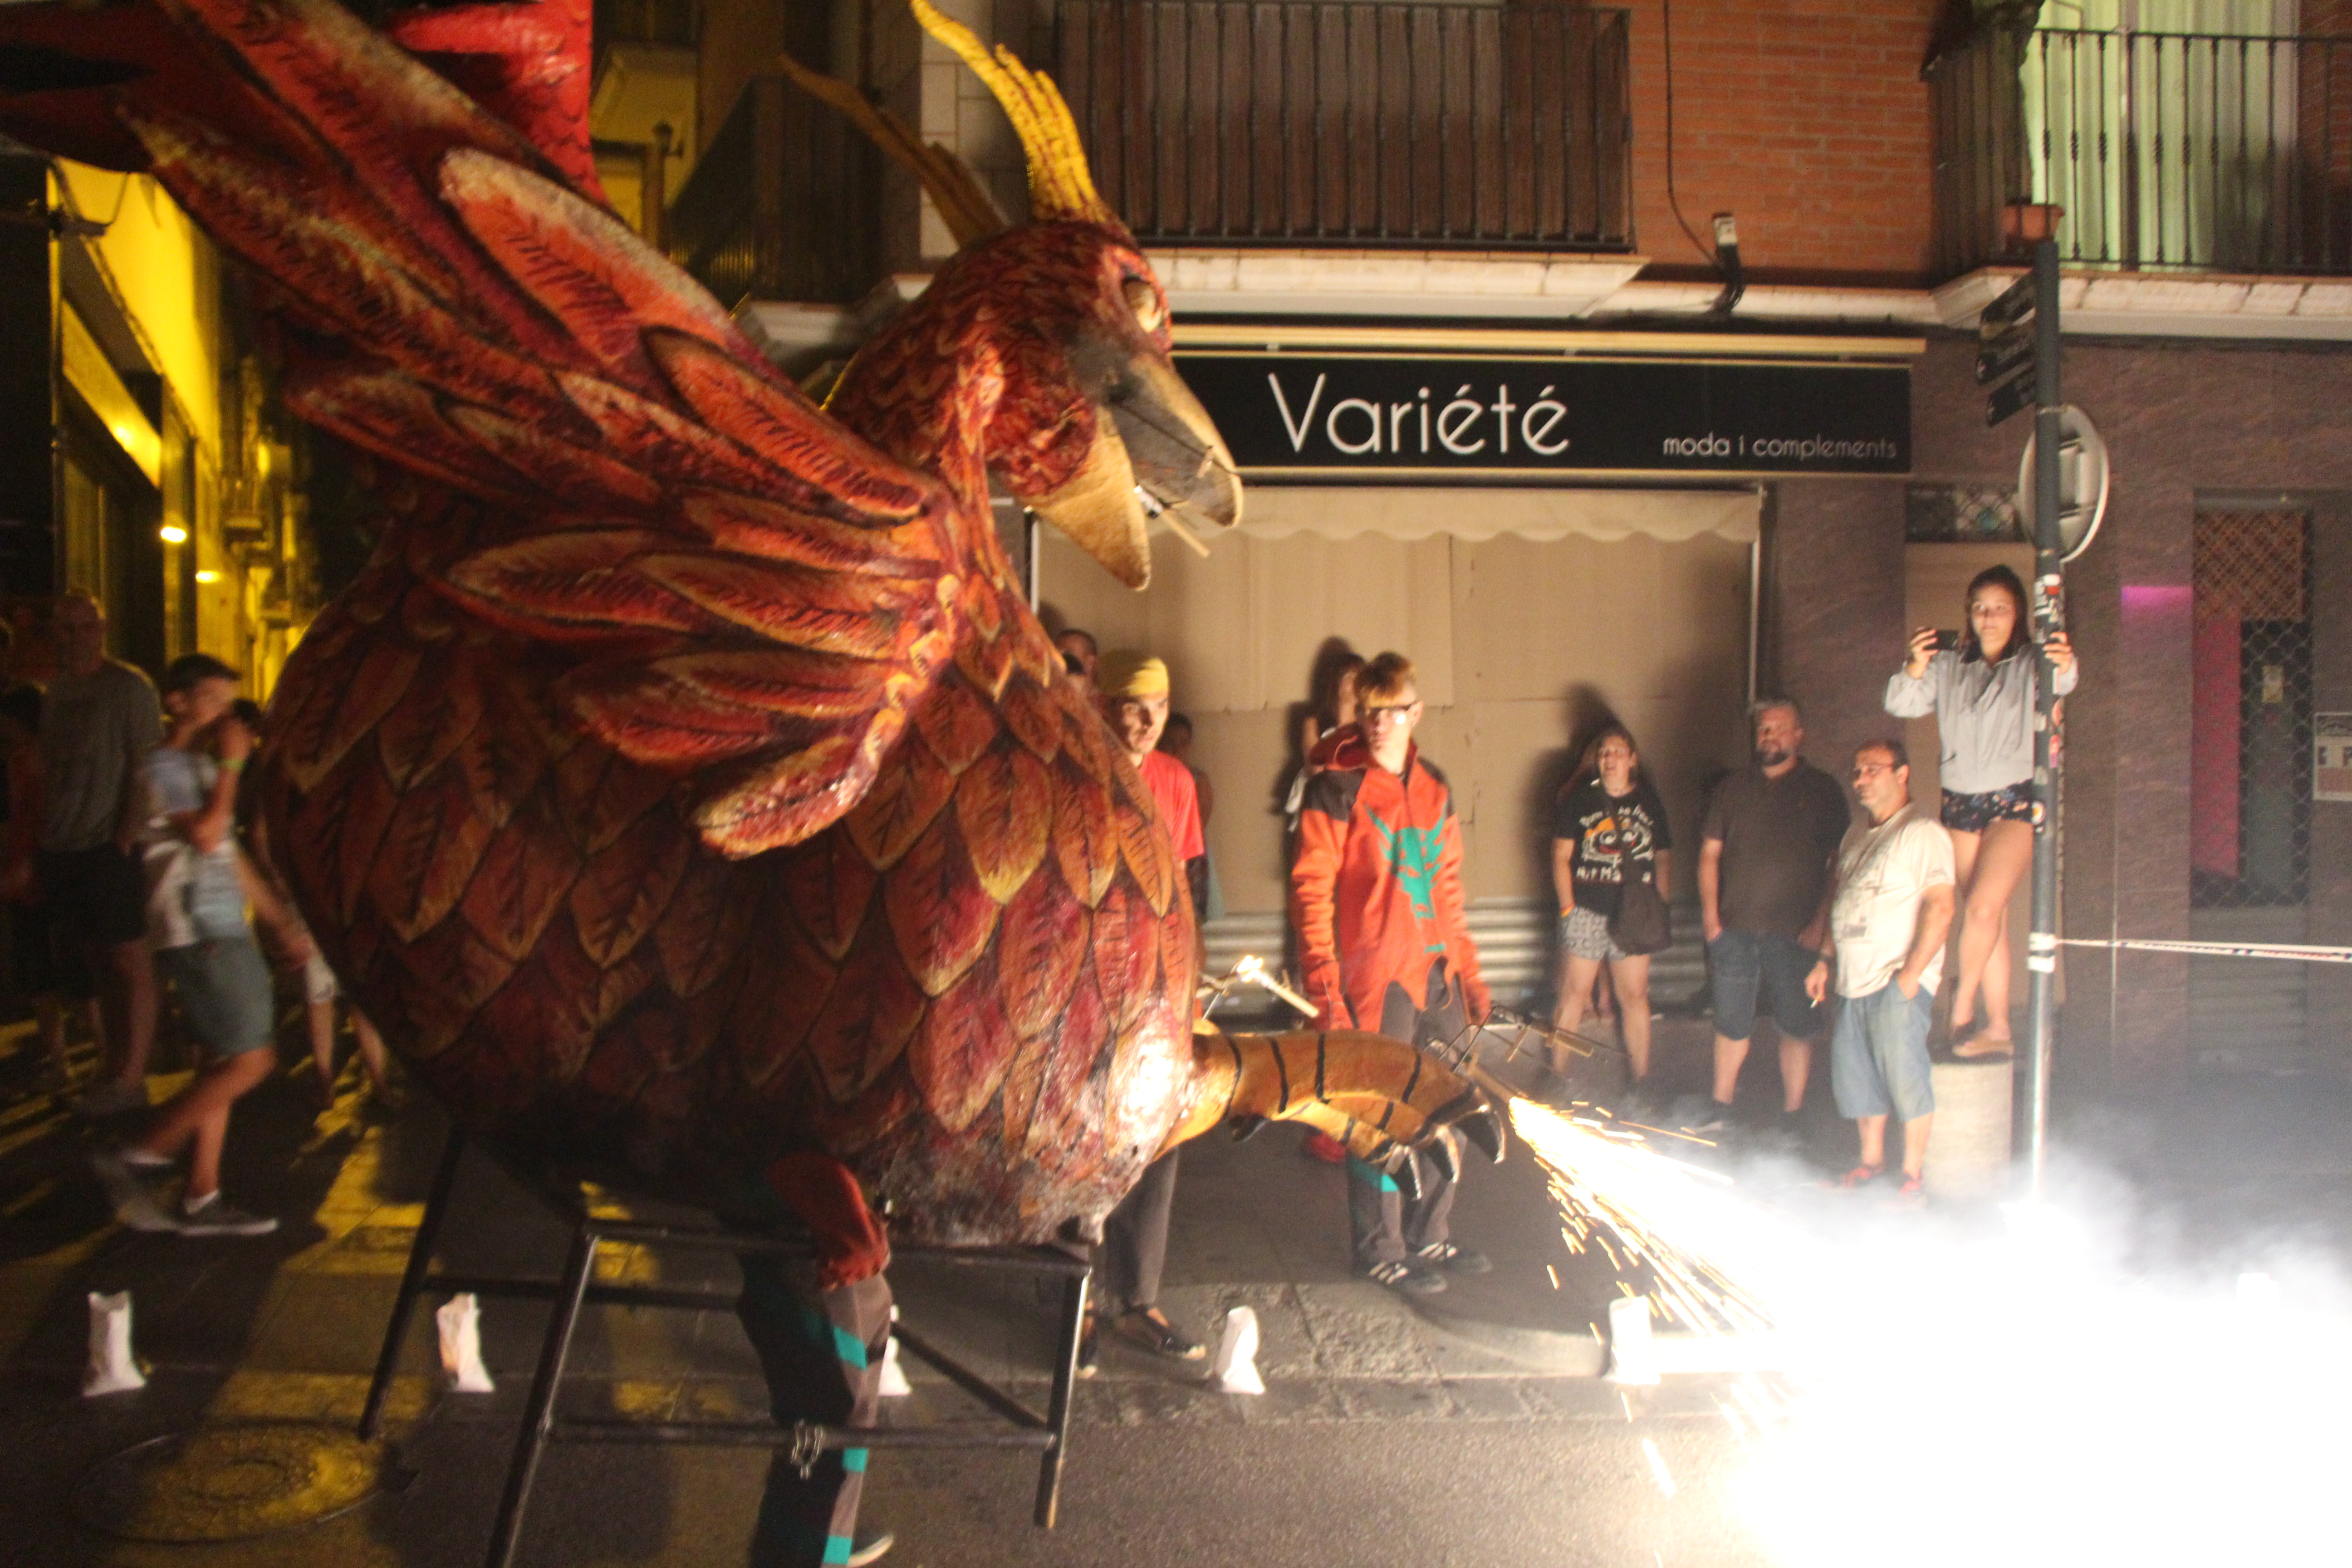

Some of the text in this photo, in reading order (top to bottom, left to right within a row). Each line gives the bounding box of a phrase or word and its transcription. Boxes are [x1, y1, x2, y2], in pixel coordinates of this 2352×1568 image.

[1268, 372, 1570, 455] Variété
[1663, 431, 1897, 461] moda i complements
